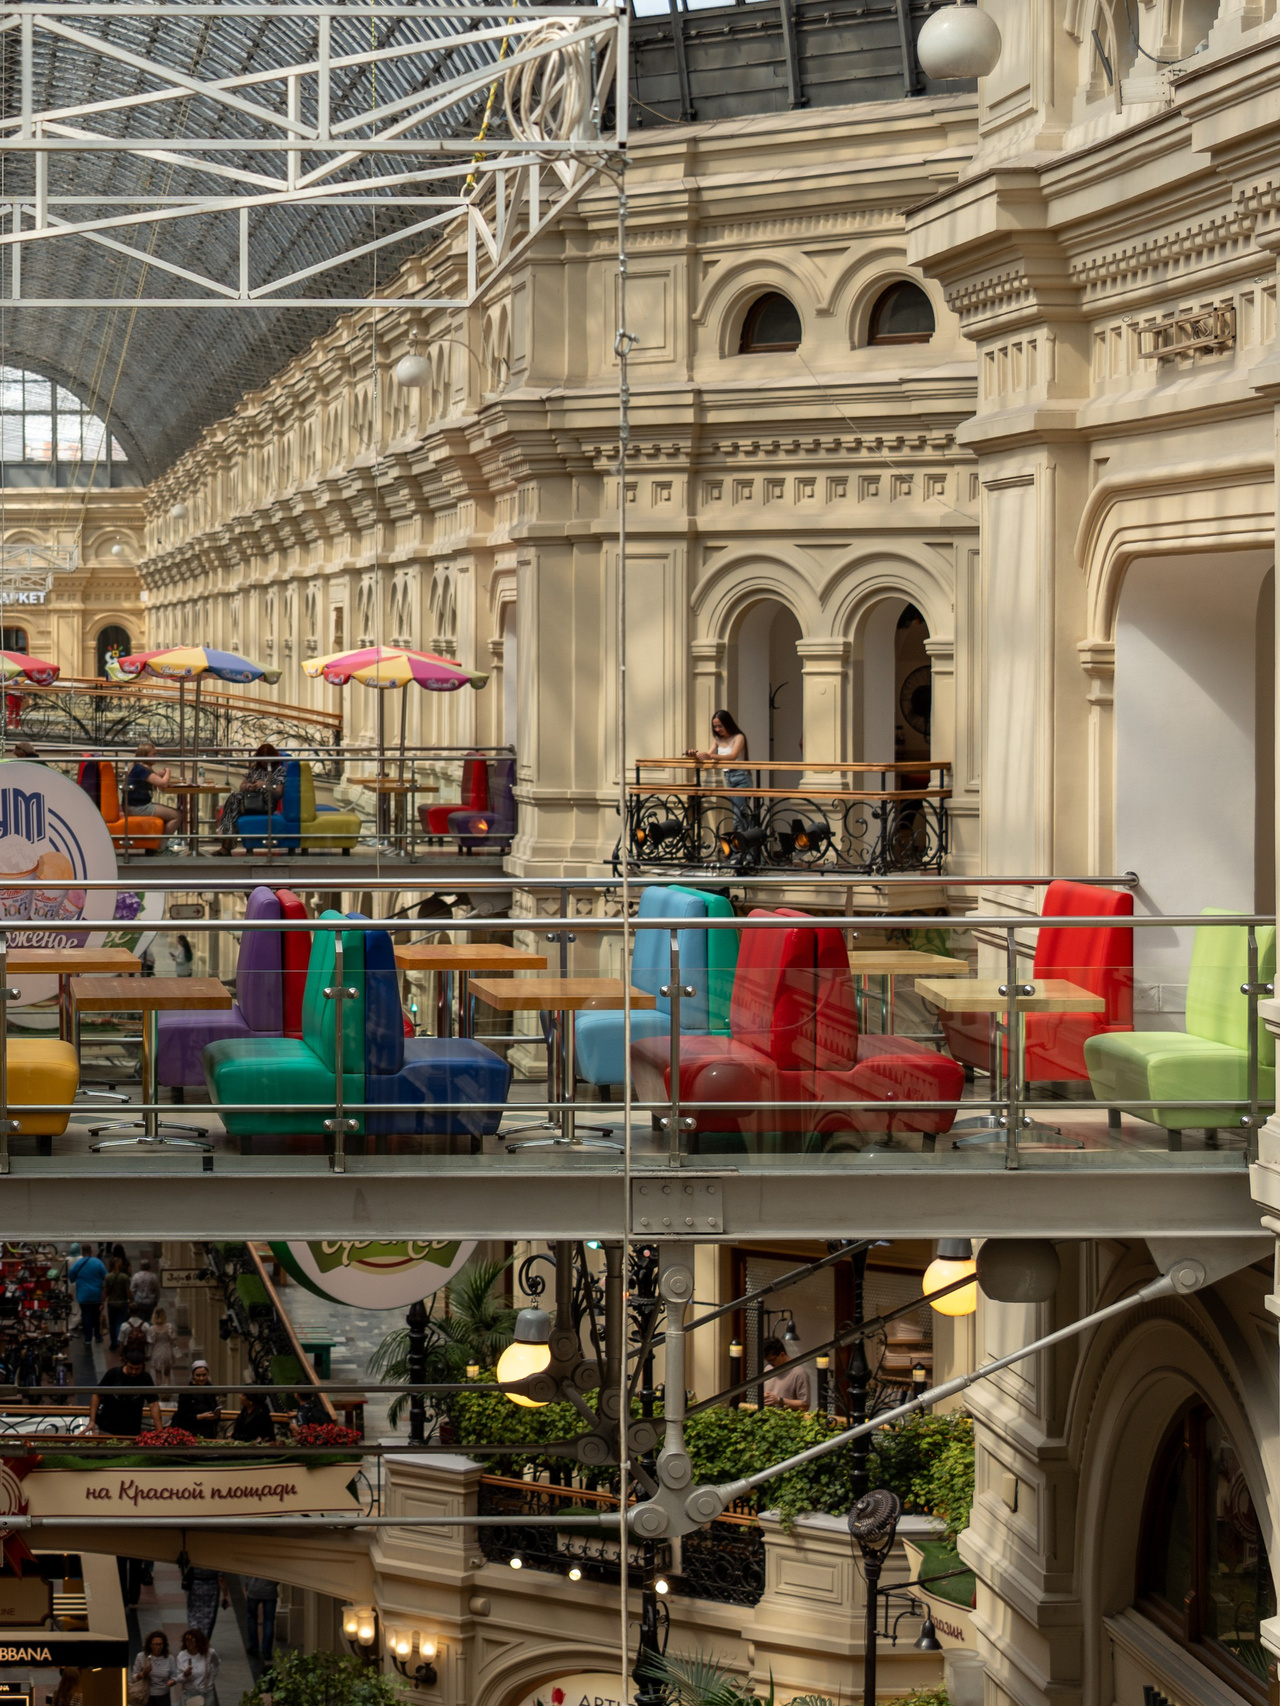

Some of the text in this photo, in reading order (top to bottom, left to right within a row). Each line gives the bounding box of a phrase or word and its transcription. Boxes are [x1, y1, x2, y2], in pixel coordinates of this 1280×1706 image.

[86, 1479, 298, 1507] на Красной площади
